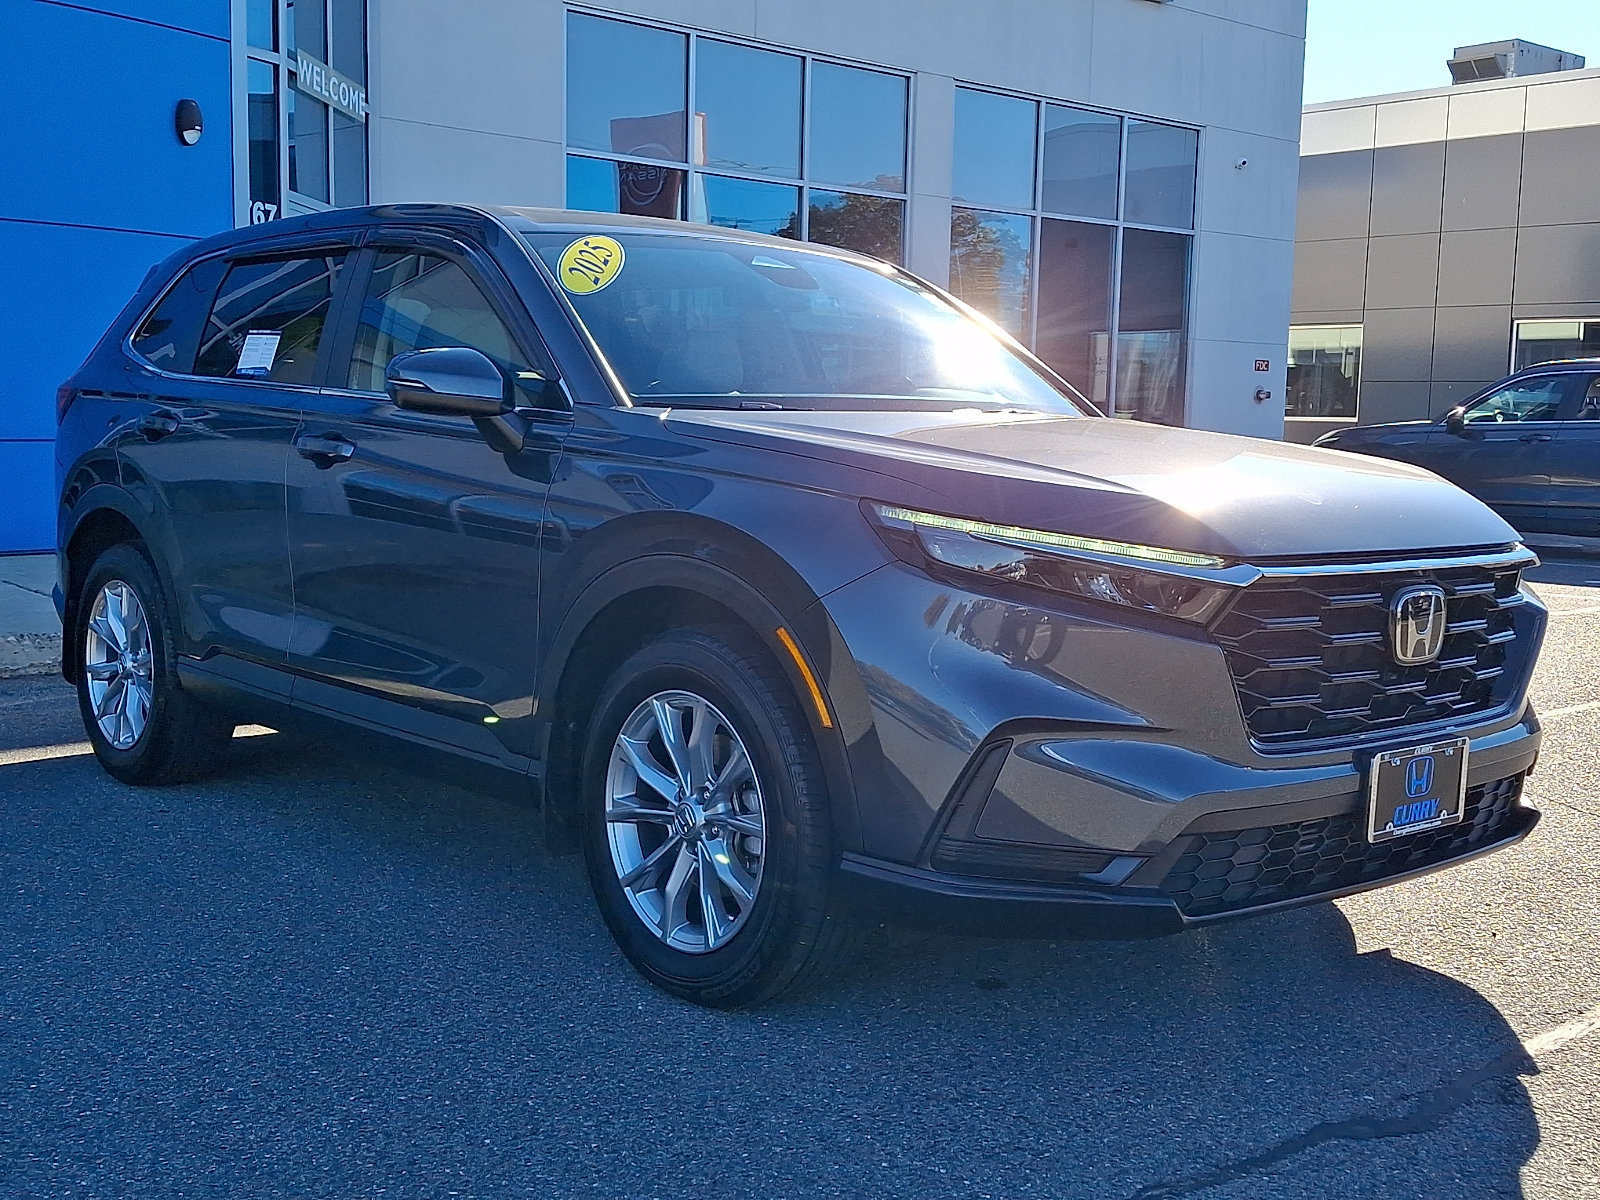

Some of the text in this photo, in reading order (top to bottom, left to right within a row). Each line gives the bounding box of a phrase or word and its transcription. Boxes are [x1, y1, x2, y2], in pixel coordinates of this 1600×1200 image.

[297, 56, 366, 117] WELCOME
[249, 201, 278, 226] 67
[568, 240, 613, 286] 2025
[1255, 360, 1268, 371] FDC
[1393, 798, 1440, 826] CURRY
